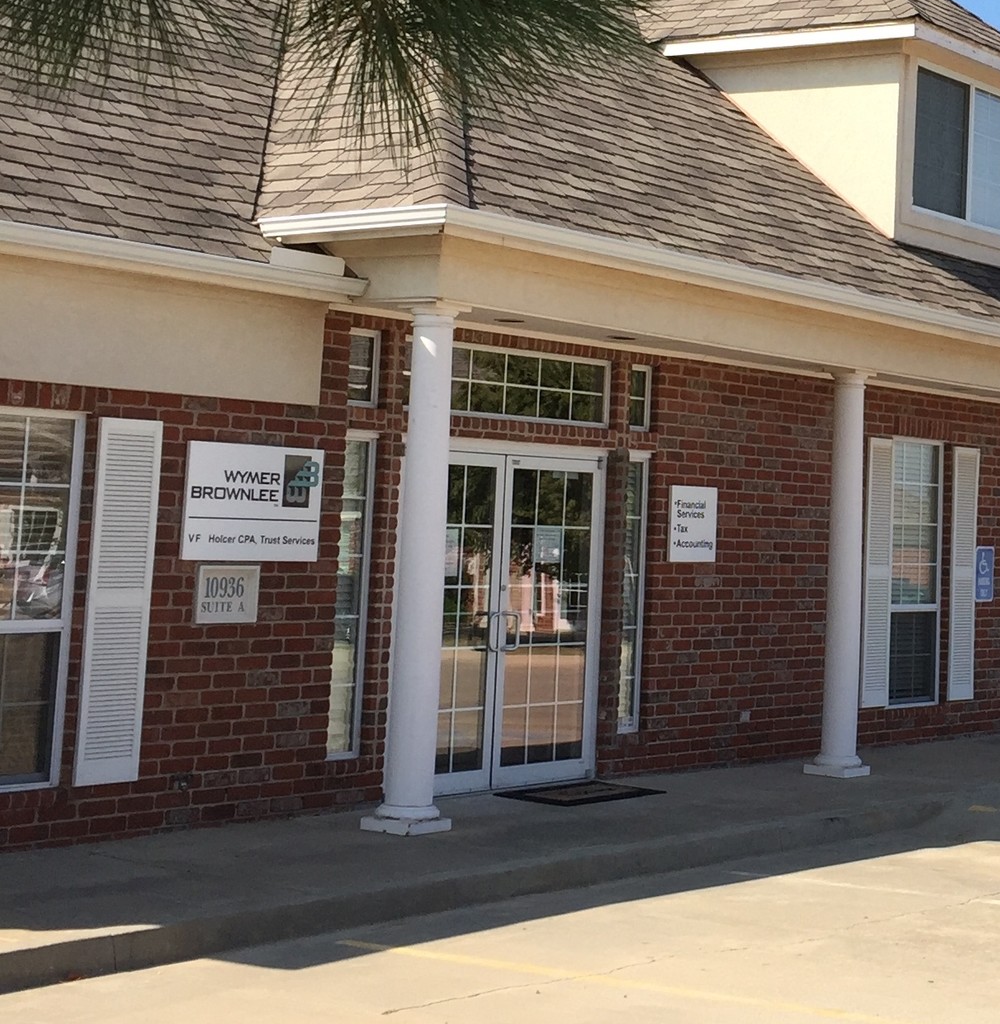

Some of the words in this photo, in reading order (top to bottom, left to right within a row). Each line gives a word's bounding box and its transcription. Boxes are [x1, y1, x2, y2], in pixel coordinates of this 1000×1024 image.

[224, 470, 280, 485] WYMER
[190, 486, 279, 502] BROWNLEE
[676, 500, 706, 509] Financial
[677, 510, 705, 519] Services
[677, 524, 688, 533] Tax
[260, 535, 281, 545] Trust
[282, 536, 315, 546] Services
[676, 540, 714, 551] Accounting
[204, 576, 245, 598] 10936
[201, 601, 233, 613] SUITE
[237, 601, 245, 613] A
